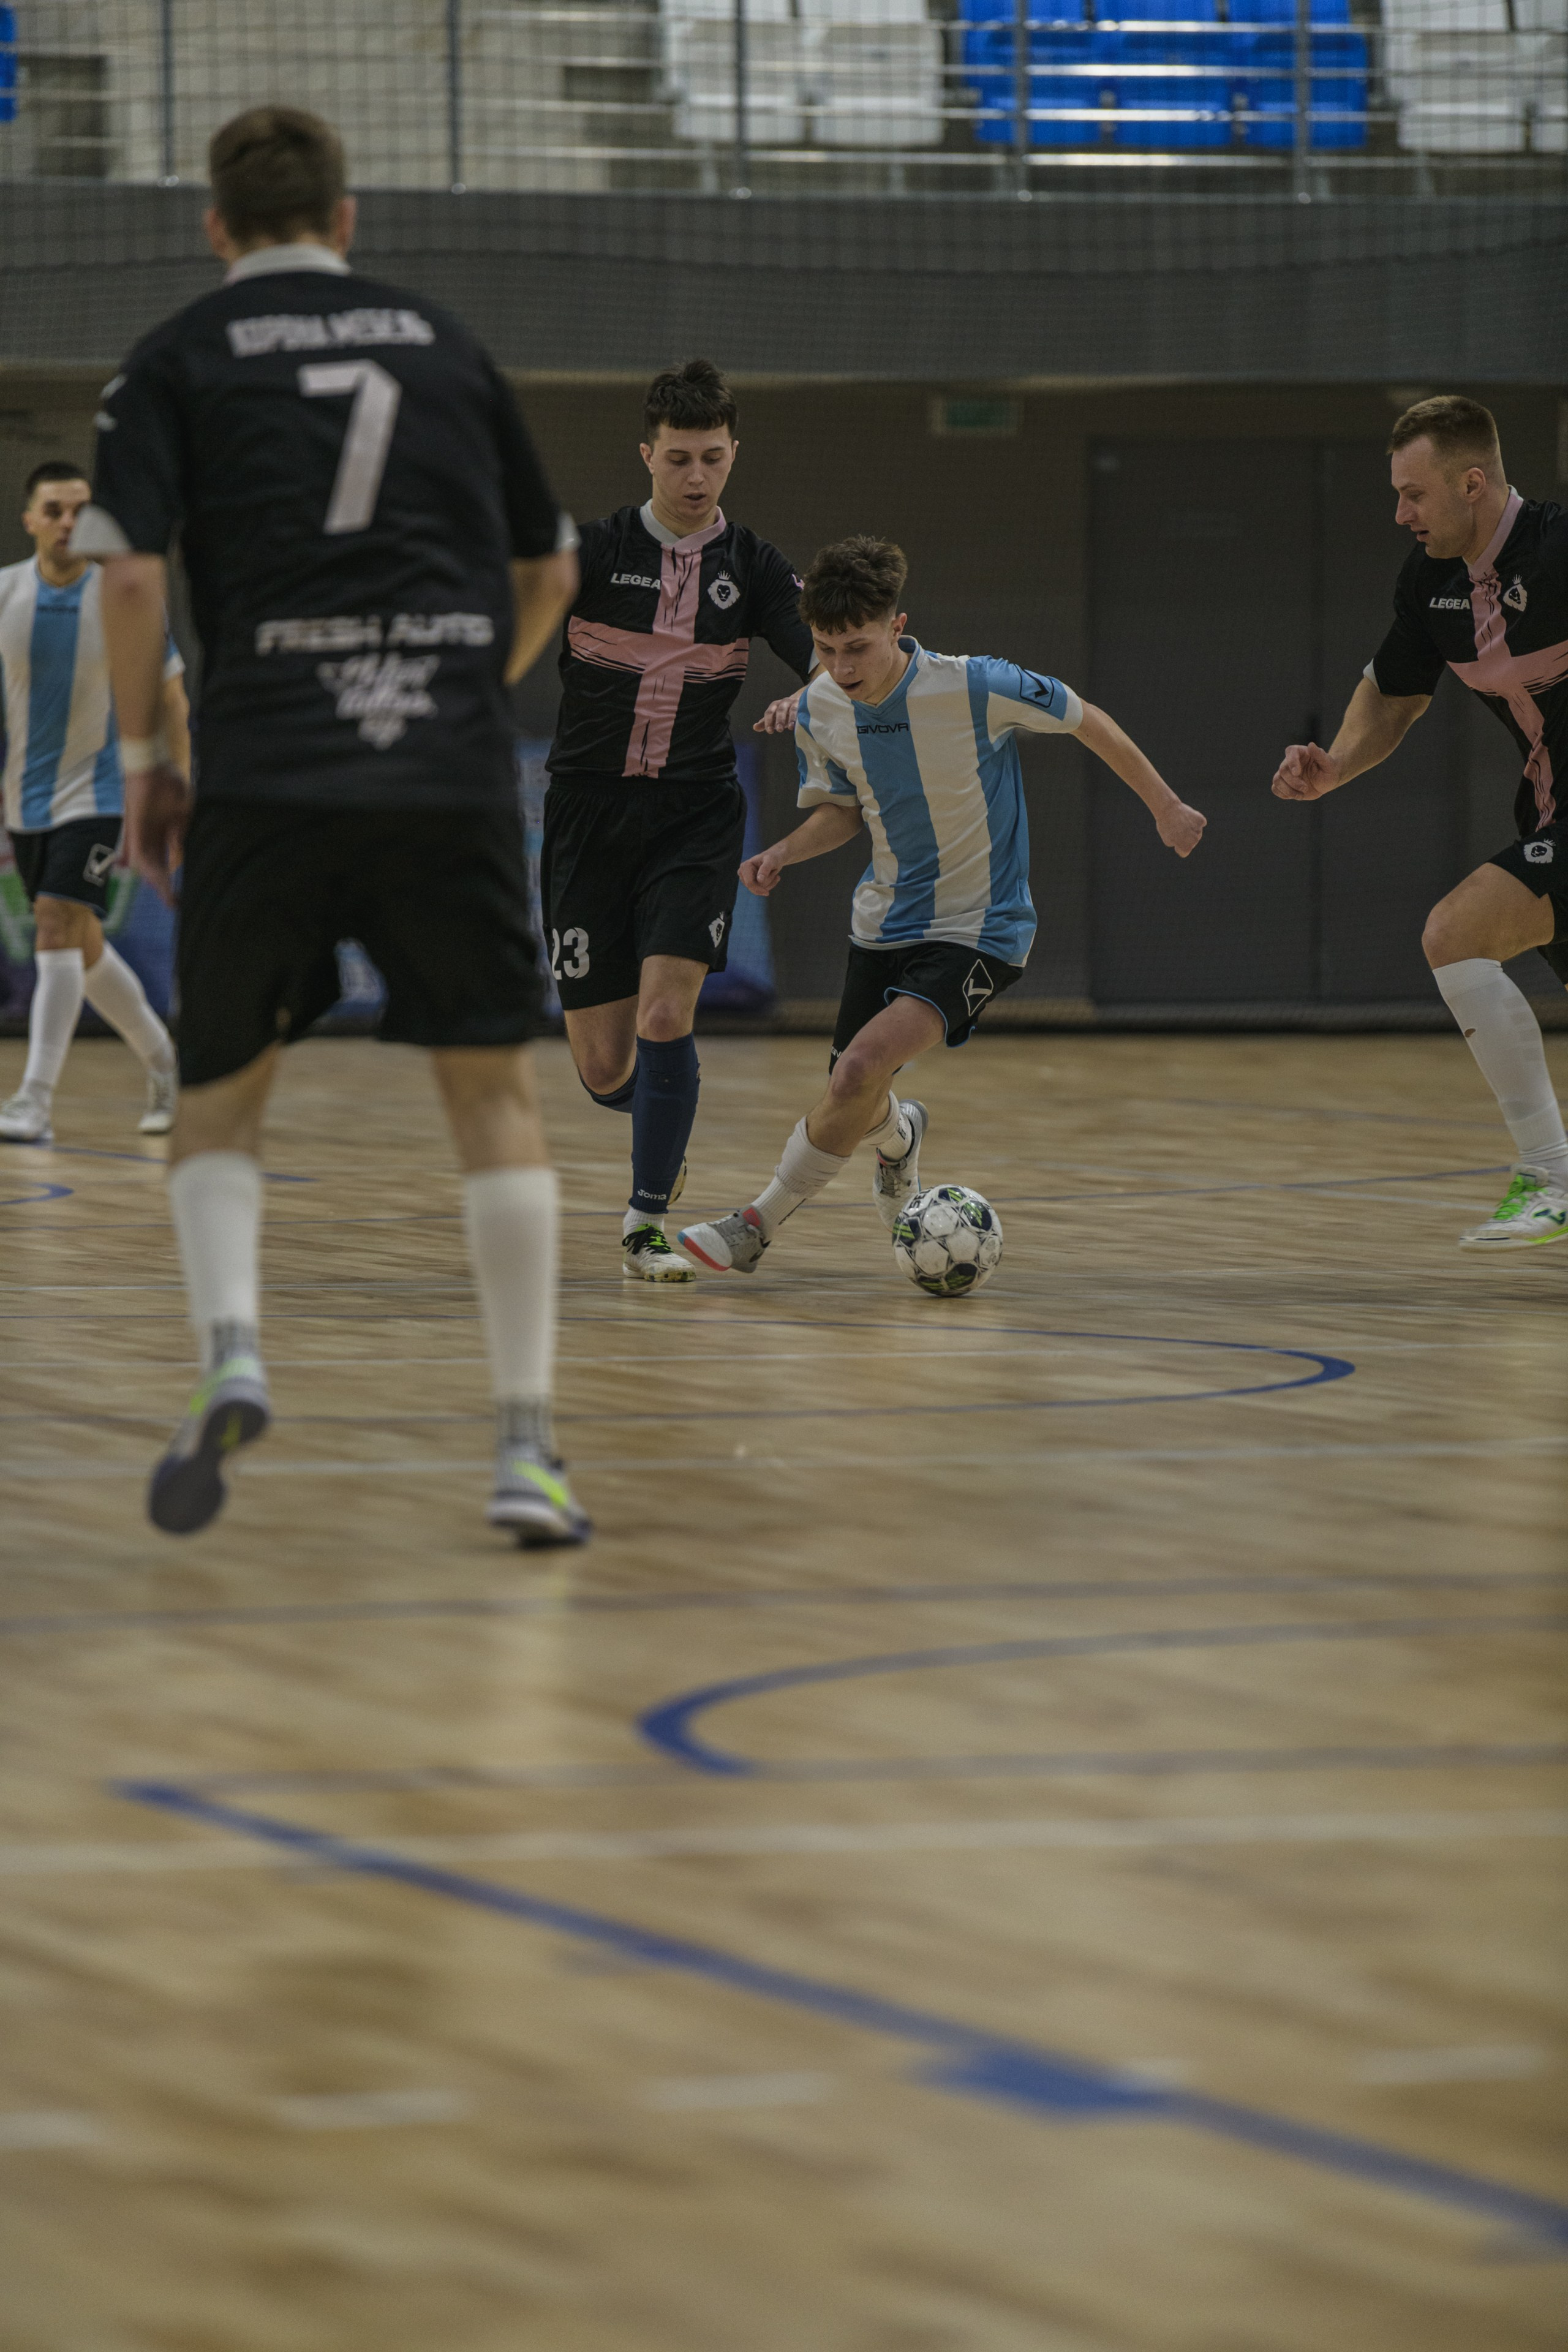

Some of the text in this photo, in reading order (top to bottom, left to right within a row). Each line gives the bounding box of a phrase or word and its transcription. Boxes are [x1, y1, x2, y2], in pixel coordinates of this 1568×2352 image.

[297, 359, 402, 535] 7
[611, 573, 661, 590] LEGEA
[1429, 597, 1471, 609] LEGEA
[857, 723, 909, 734] GIVOVA
[552, 927, 590, 980] 23
[638, 1189, 667, 1200] Joma
